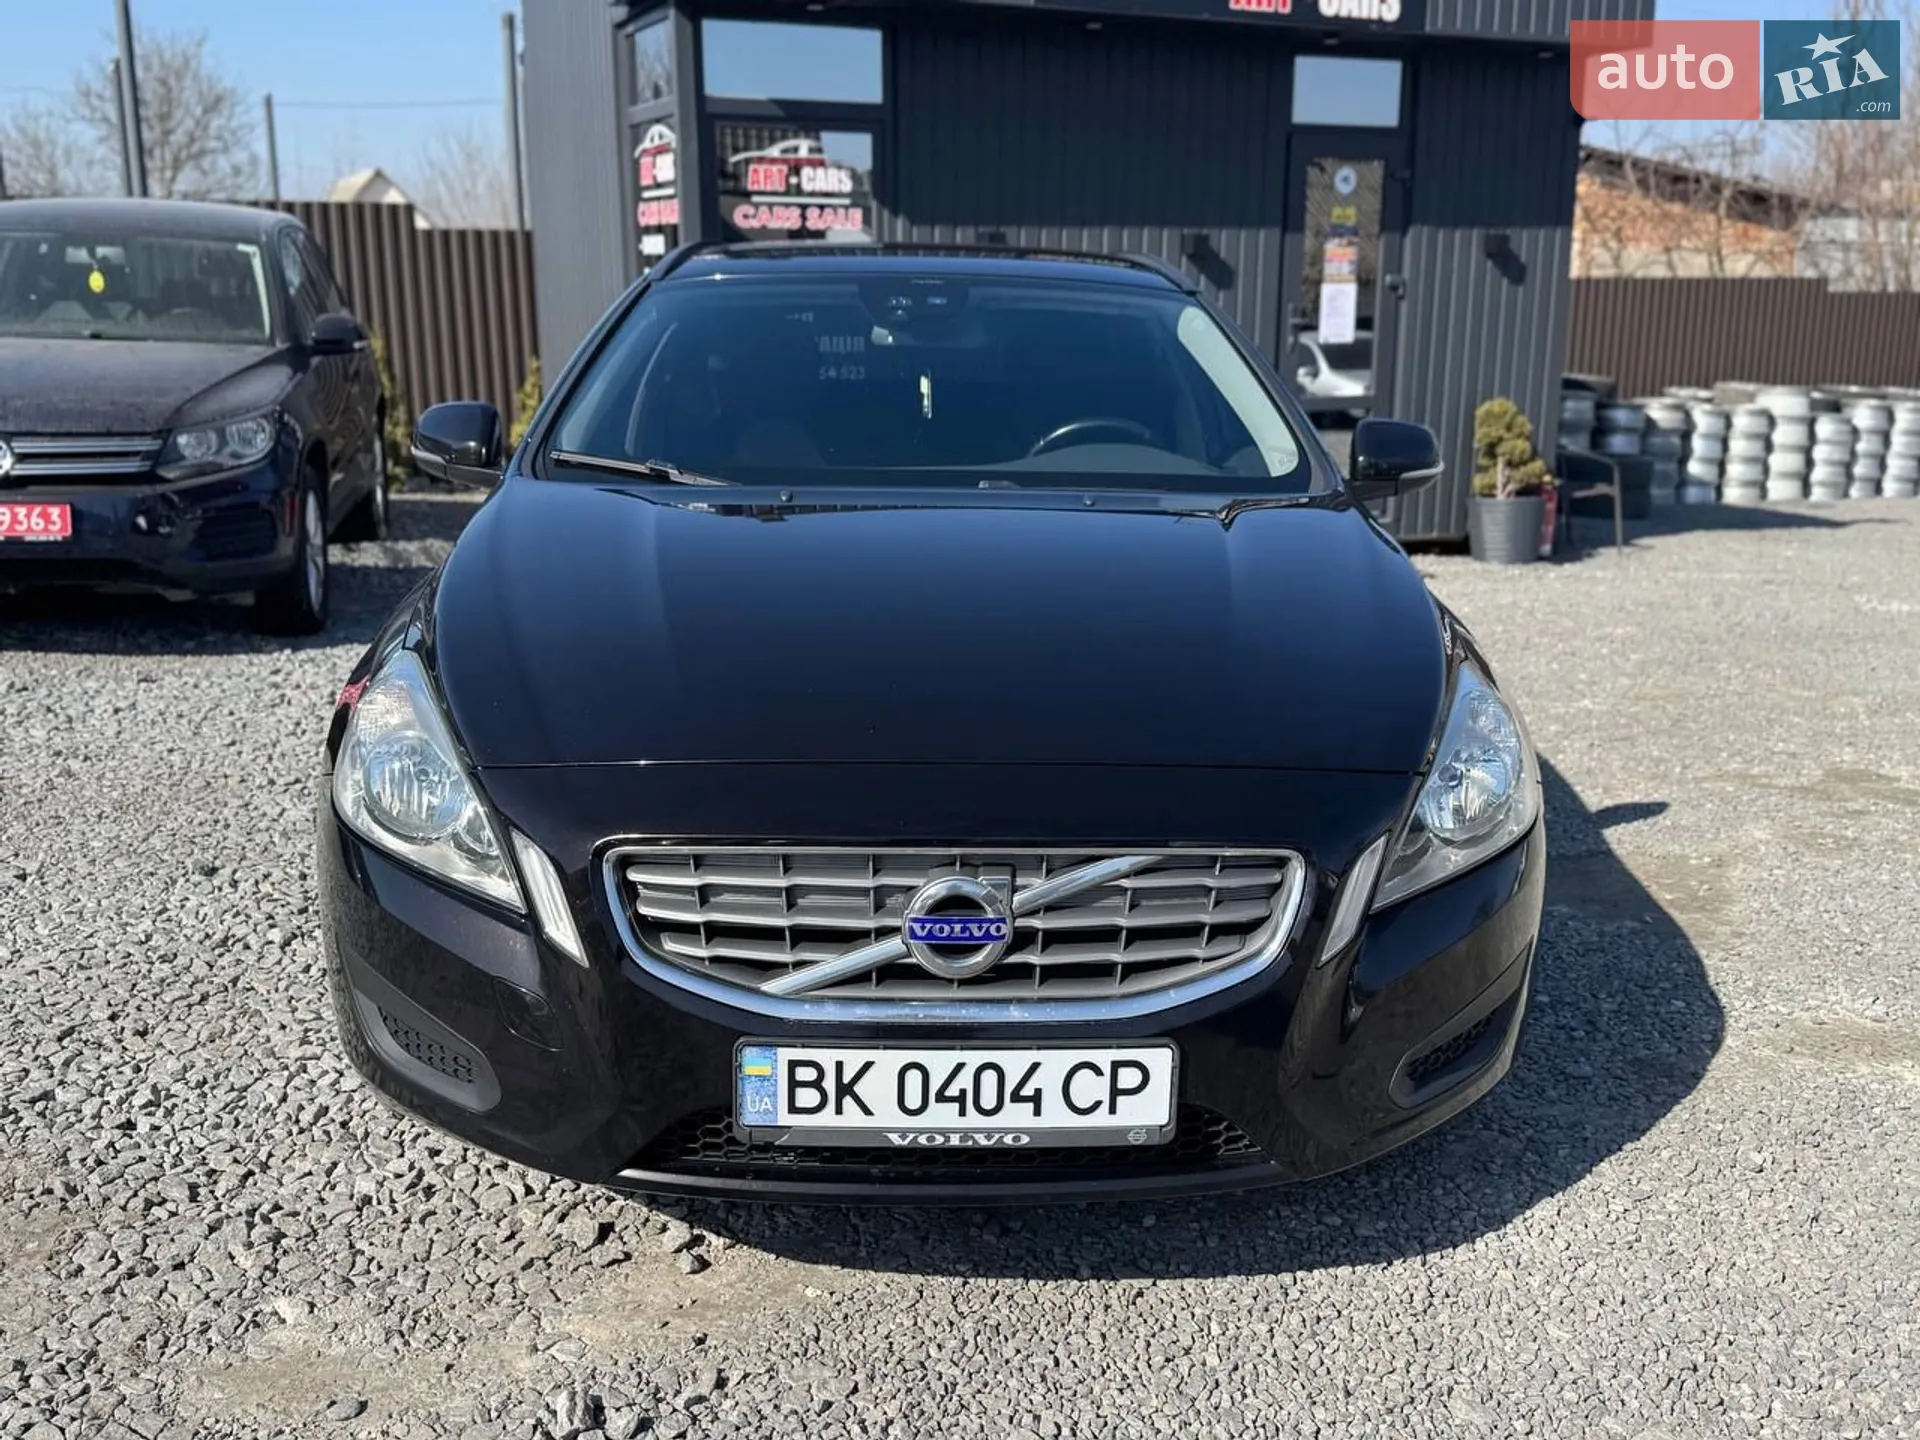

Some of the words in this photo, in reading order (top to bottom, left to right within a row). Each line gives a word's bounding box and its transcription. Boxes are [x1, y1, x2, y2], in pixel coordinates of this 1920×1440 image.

[747, 164, 788, 192] ART
[800, 165, 853, 193] CARS
[733, 204, 802, 229] CARS
[804, 205, 863, 231] SALE
[909, 922, 1009, 937] VOLVO
[747, 1095, 774, 1112] UA
[787, 1060, 876, 1117] BK
[897, 1061, 1043, 1117] 0404
[1061, 1059, 1151, 1117] CP
[884, 1132, 1031, 1146] VOLVO
